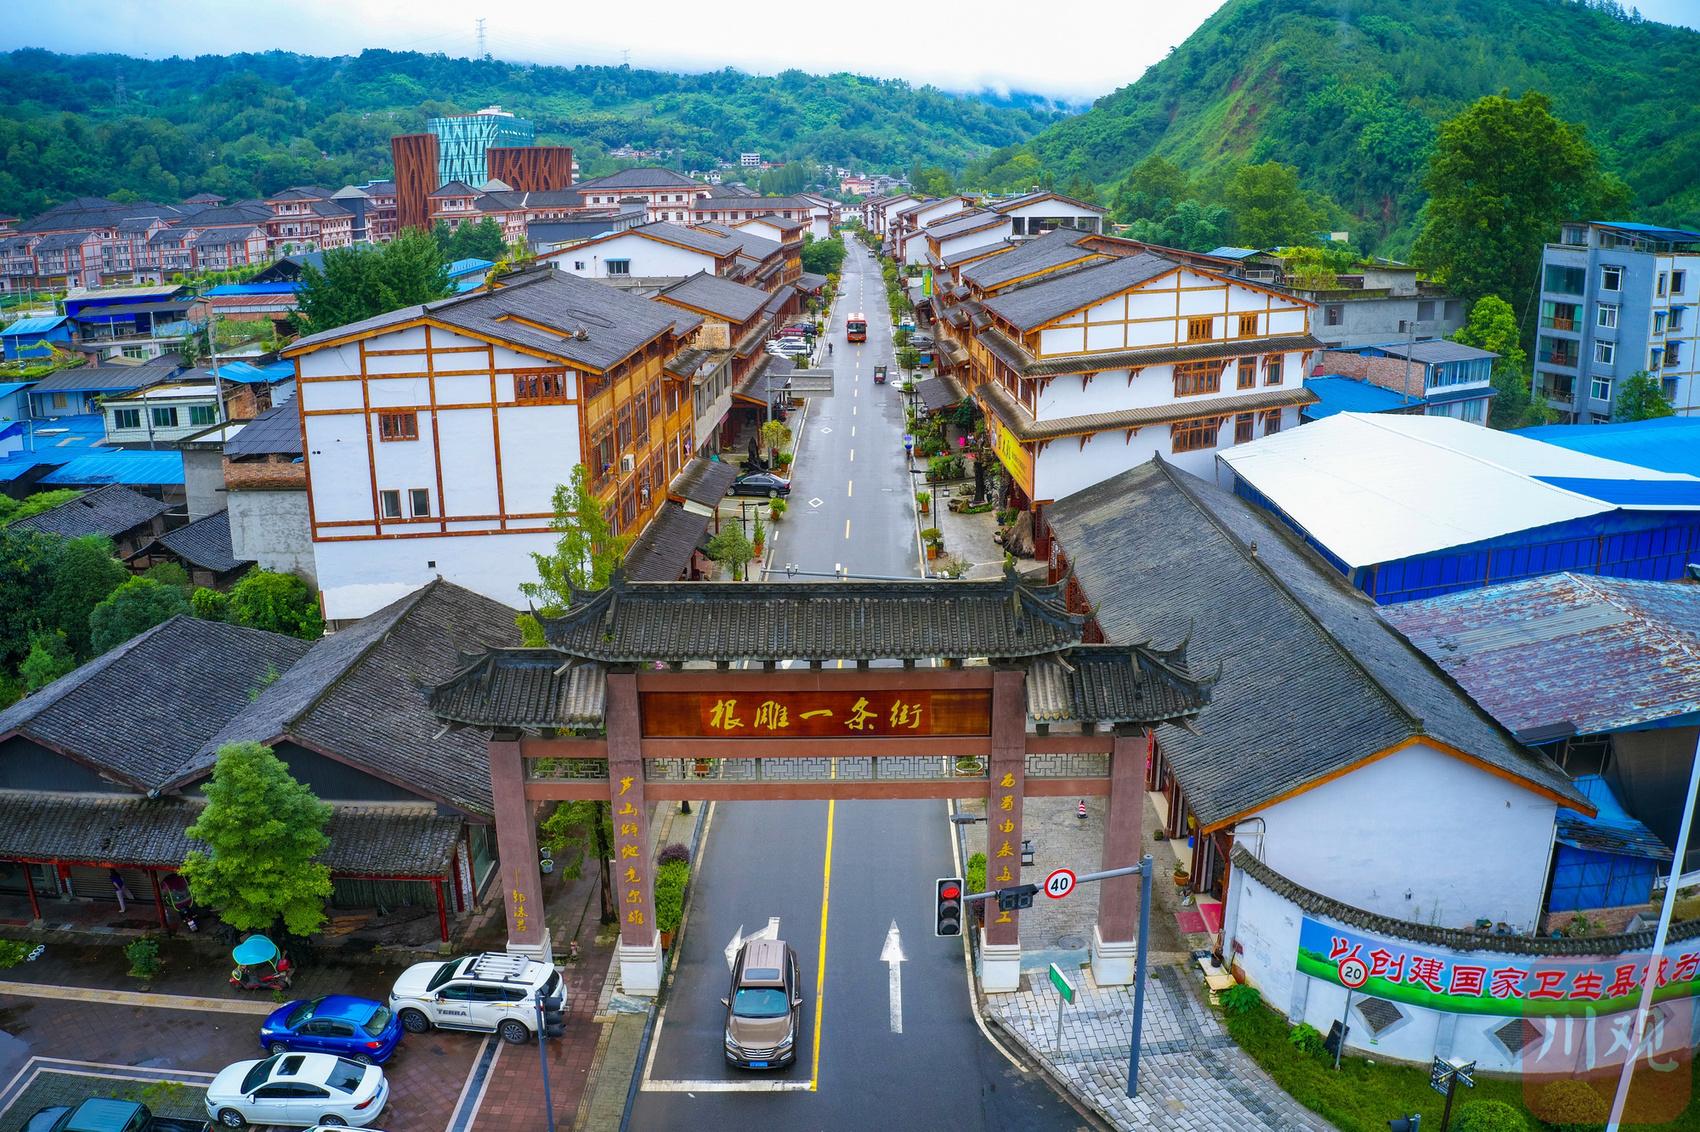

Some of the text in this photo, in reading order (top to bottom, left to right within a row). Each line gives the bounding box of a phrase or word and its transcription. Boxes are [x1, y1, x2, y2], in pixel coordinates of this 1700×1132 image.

[709, 696, 923, 731] 根雕一条街
[996, 773, 1016, 922] 西蜀由来多工
[1051, 877, 1069, 892] 40
[1344, 966, 1362, 980] 20
[436, 1008, 467, 1017] TERRA
